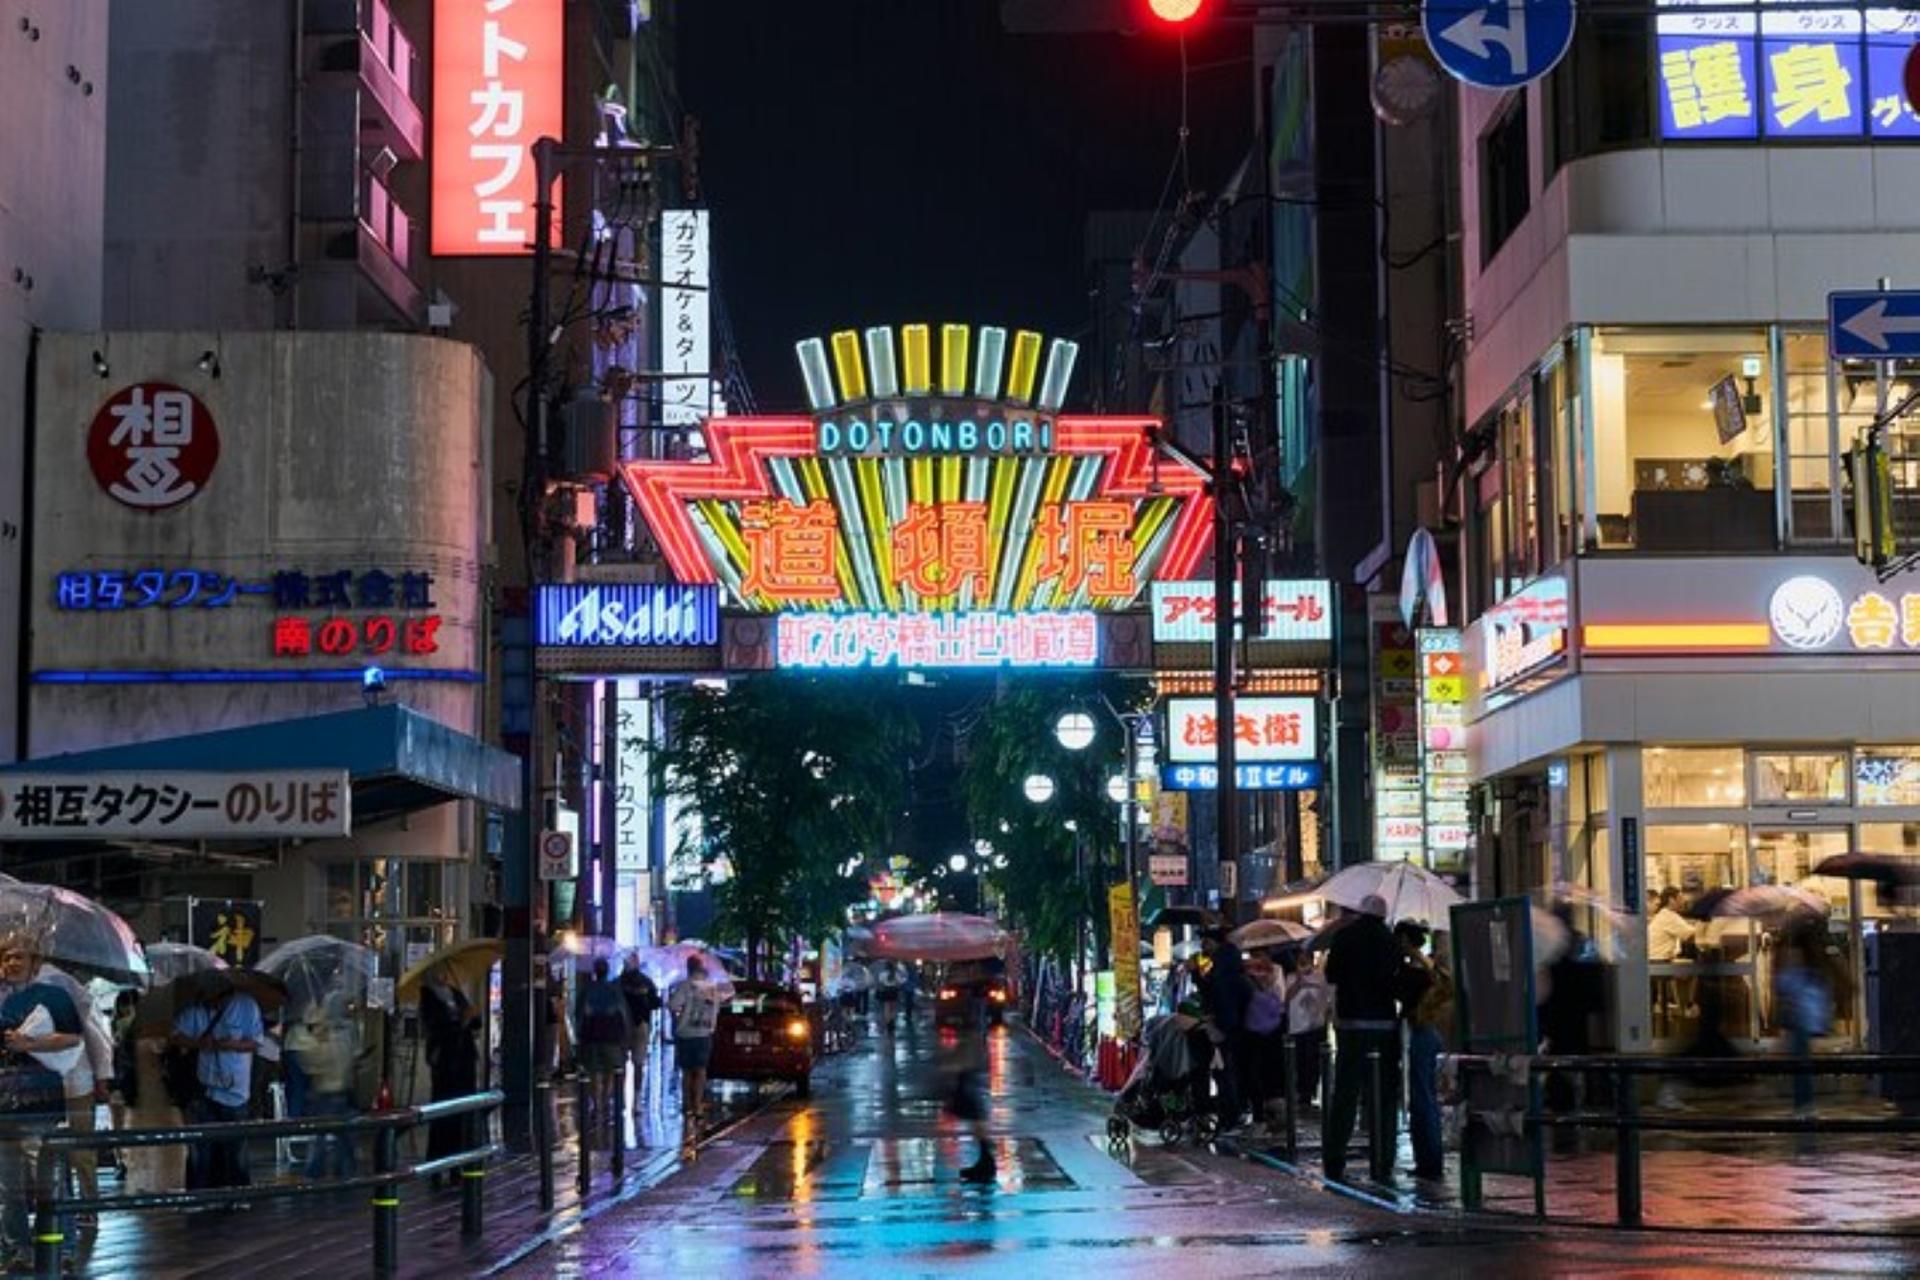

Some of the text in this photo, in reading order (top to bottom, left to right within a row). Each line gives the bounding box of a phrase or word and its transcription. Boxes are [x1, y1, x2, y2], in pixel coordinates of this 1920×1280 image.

[820, 420, 1053, 452] DOTONBORI
[741, 500, 1137, 598] 道頓堀
[273, 616, 441, 656] 南のりば
[558, 589, 697, 642] Asahi
[14, 781, 339, 827] 相互タクシーのりば
